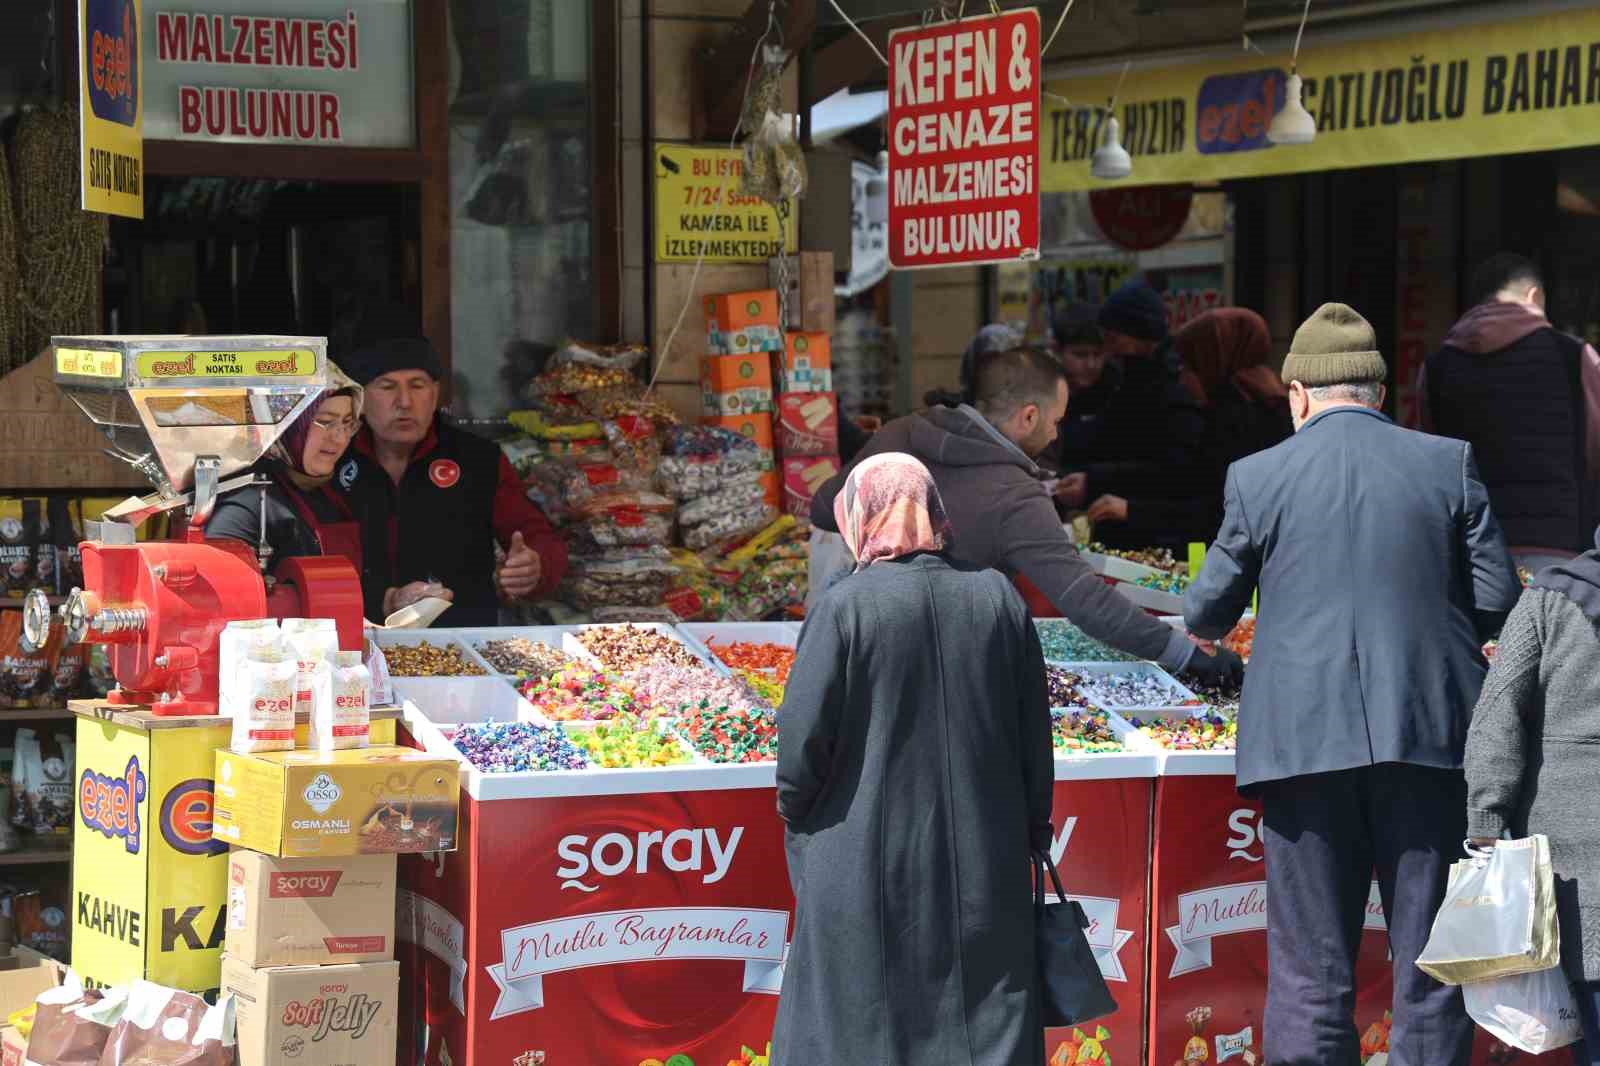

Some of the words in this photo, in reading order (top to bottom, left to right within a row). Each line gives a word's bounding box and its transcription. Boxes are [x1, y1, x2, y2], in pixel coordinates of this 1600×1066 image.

[156, 11, 359, 69] MALZEMESİ
[894, 28, 997, 107] KEFEN
[1008, 22, 1032, 91] &
[178, 86, 341, 140] BULUNUR
[894, 102, 1034, 156] CENAZE
[1123, 98, 1186, 157] HIZIR
[1199, 77, 1276, 145] ezel
[692, 159, 711, 176] BU
[680, 213, 742, 232] KAMERA
[904, 209, 1021, 257] BULUNUR
[151, 352, 196, 376] ezel
[205, 364, 243, 375] NOKTASI
[255, 352, 299, 375] ezel
[255, 695, 293, 713] ezel
[336, 690, 366, 708] ezel
[80, 764, 138, 834] ezel
[306, 788, 338, 801] OSSO
[291, 819, 352, 831] OSMANLI
[78, 891, 140, 947] KAHVE
[512, 920, 608, 972] Mutlu
[615, 915, 769, 956] Bayramlar
[282, 997, 323, 1028] Soft
[312, 993, 382, 1042] Jelly
